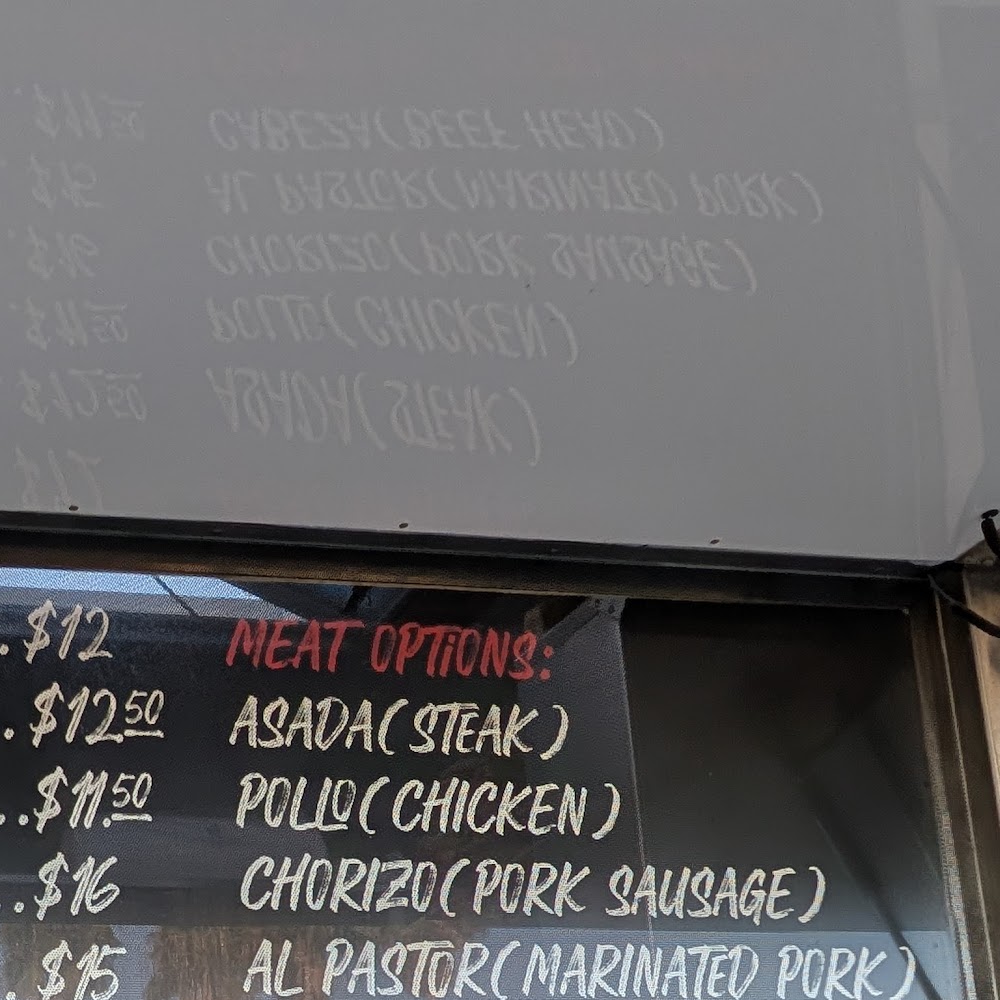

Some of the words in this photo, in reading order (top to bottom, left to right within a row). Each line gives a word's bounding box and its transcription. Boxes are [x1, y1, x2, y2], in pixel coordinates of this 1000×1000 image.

[23, 600, 113, 664] $12
[225, 618, 366, 673] MEAT
[370, 623, 553, 680] OPTIONS:
[35, 853, 120, 920] $16
[243, 938, 303, 998] AL
